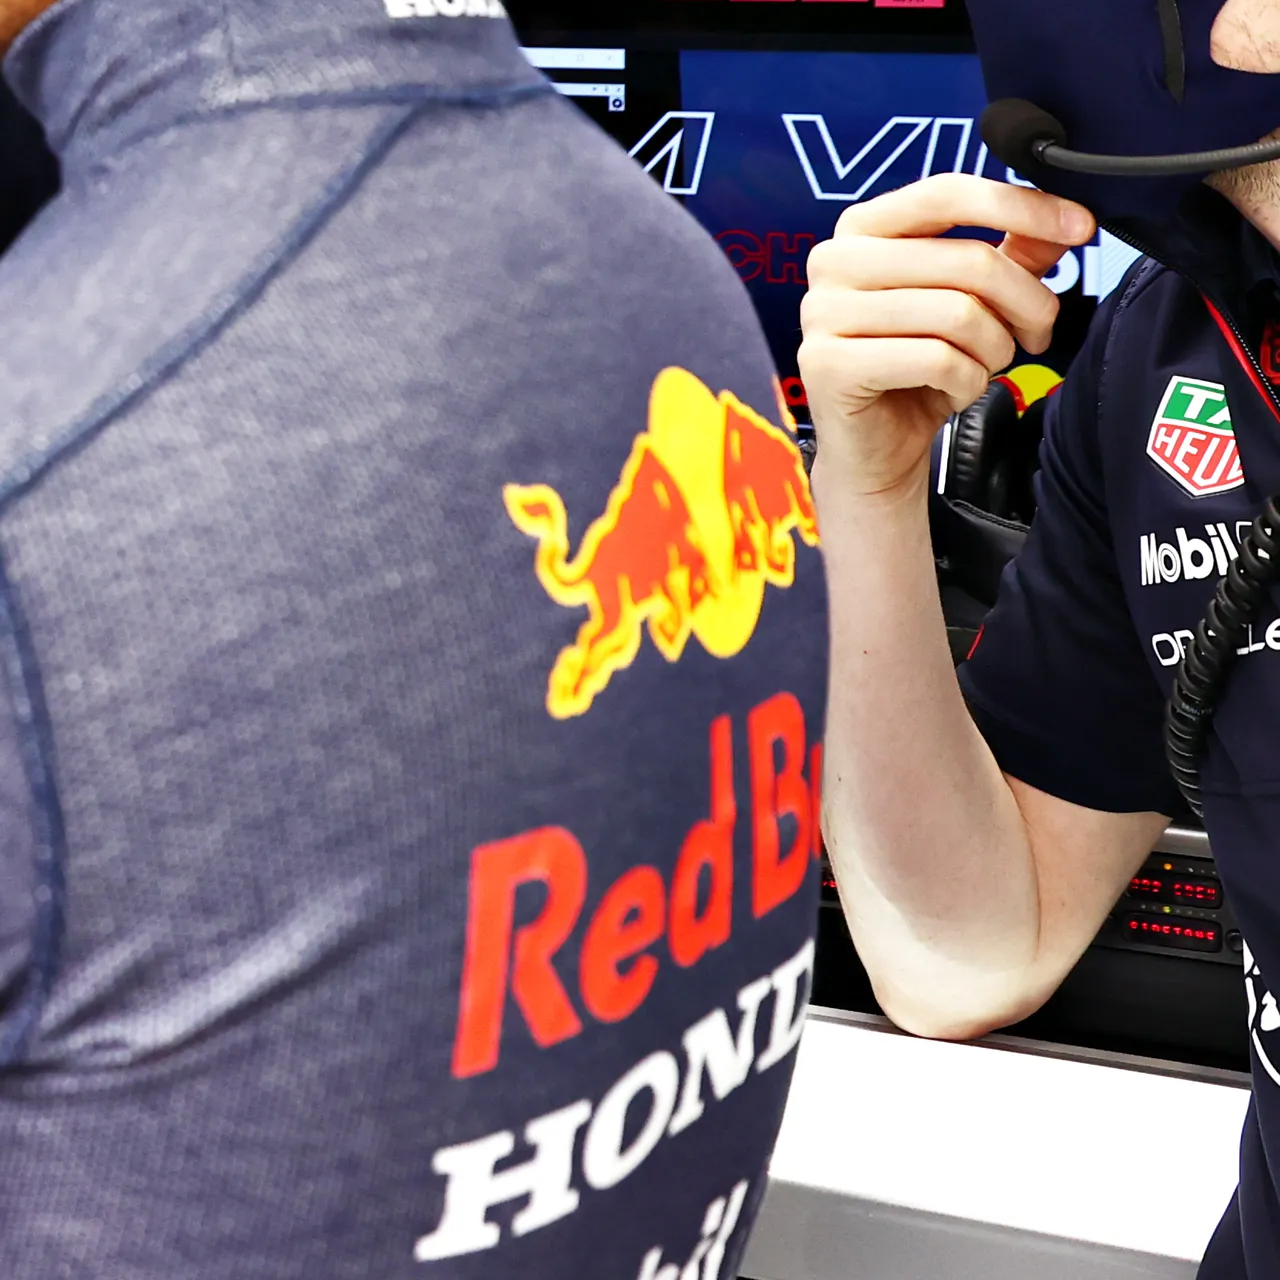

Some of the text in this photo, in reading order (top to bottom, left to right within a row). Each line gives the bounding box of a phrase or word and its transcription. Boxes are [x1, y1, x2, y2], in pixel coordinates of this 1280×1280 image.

[780, 113, 990, 201] VI
[1154, 425, 1245, 489] HEU
[1139, 522, 1240, 587] Mobil
[449, 712, 737, 1080] Red
[412, 935, 818, 1263] HOND
